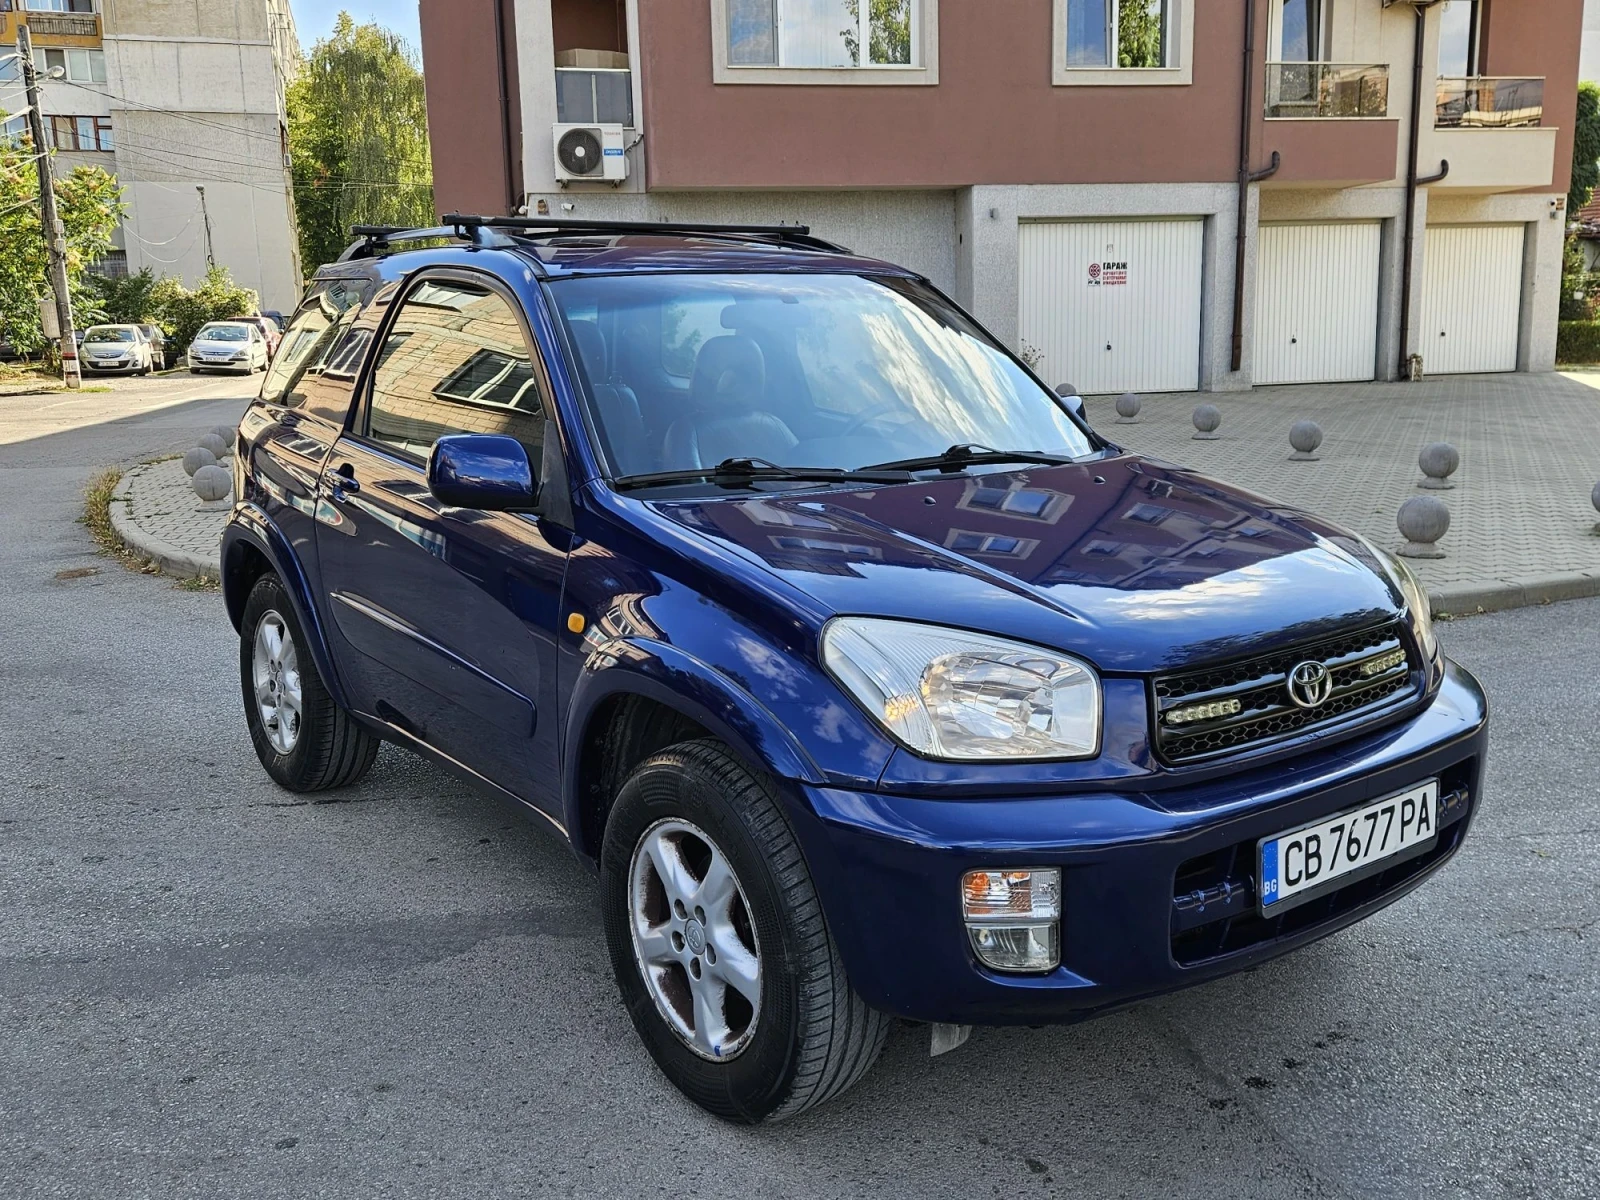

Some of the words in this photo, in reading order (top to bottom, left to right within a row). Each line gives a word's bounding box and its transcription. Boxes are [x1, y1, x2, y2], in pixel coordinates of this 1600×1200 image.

[1103, 262, 1127, 270] ГАРАЖ
[1285, 833, 1322, 887] CB
[1329, 805, 1395, 871] 7677
[1400, 792, 1431, 843] PA
[1264, 879, 1277, 895] BG
